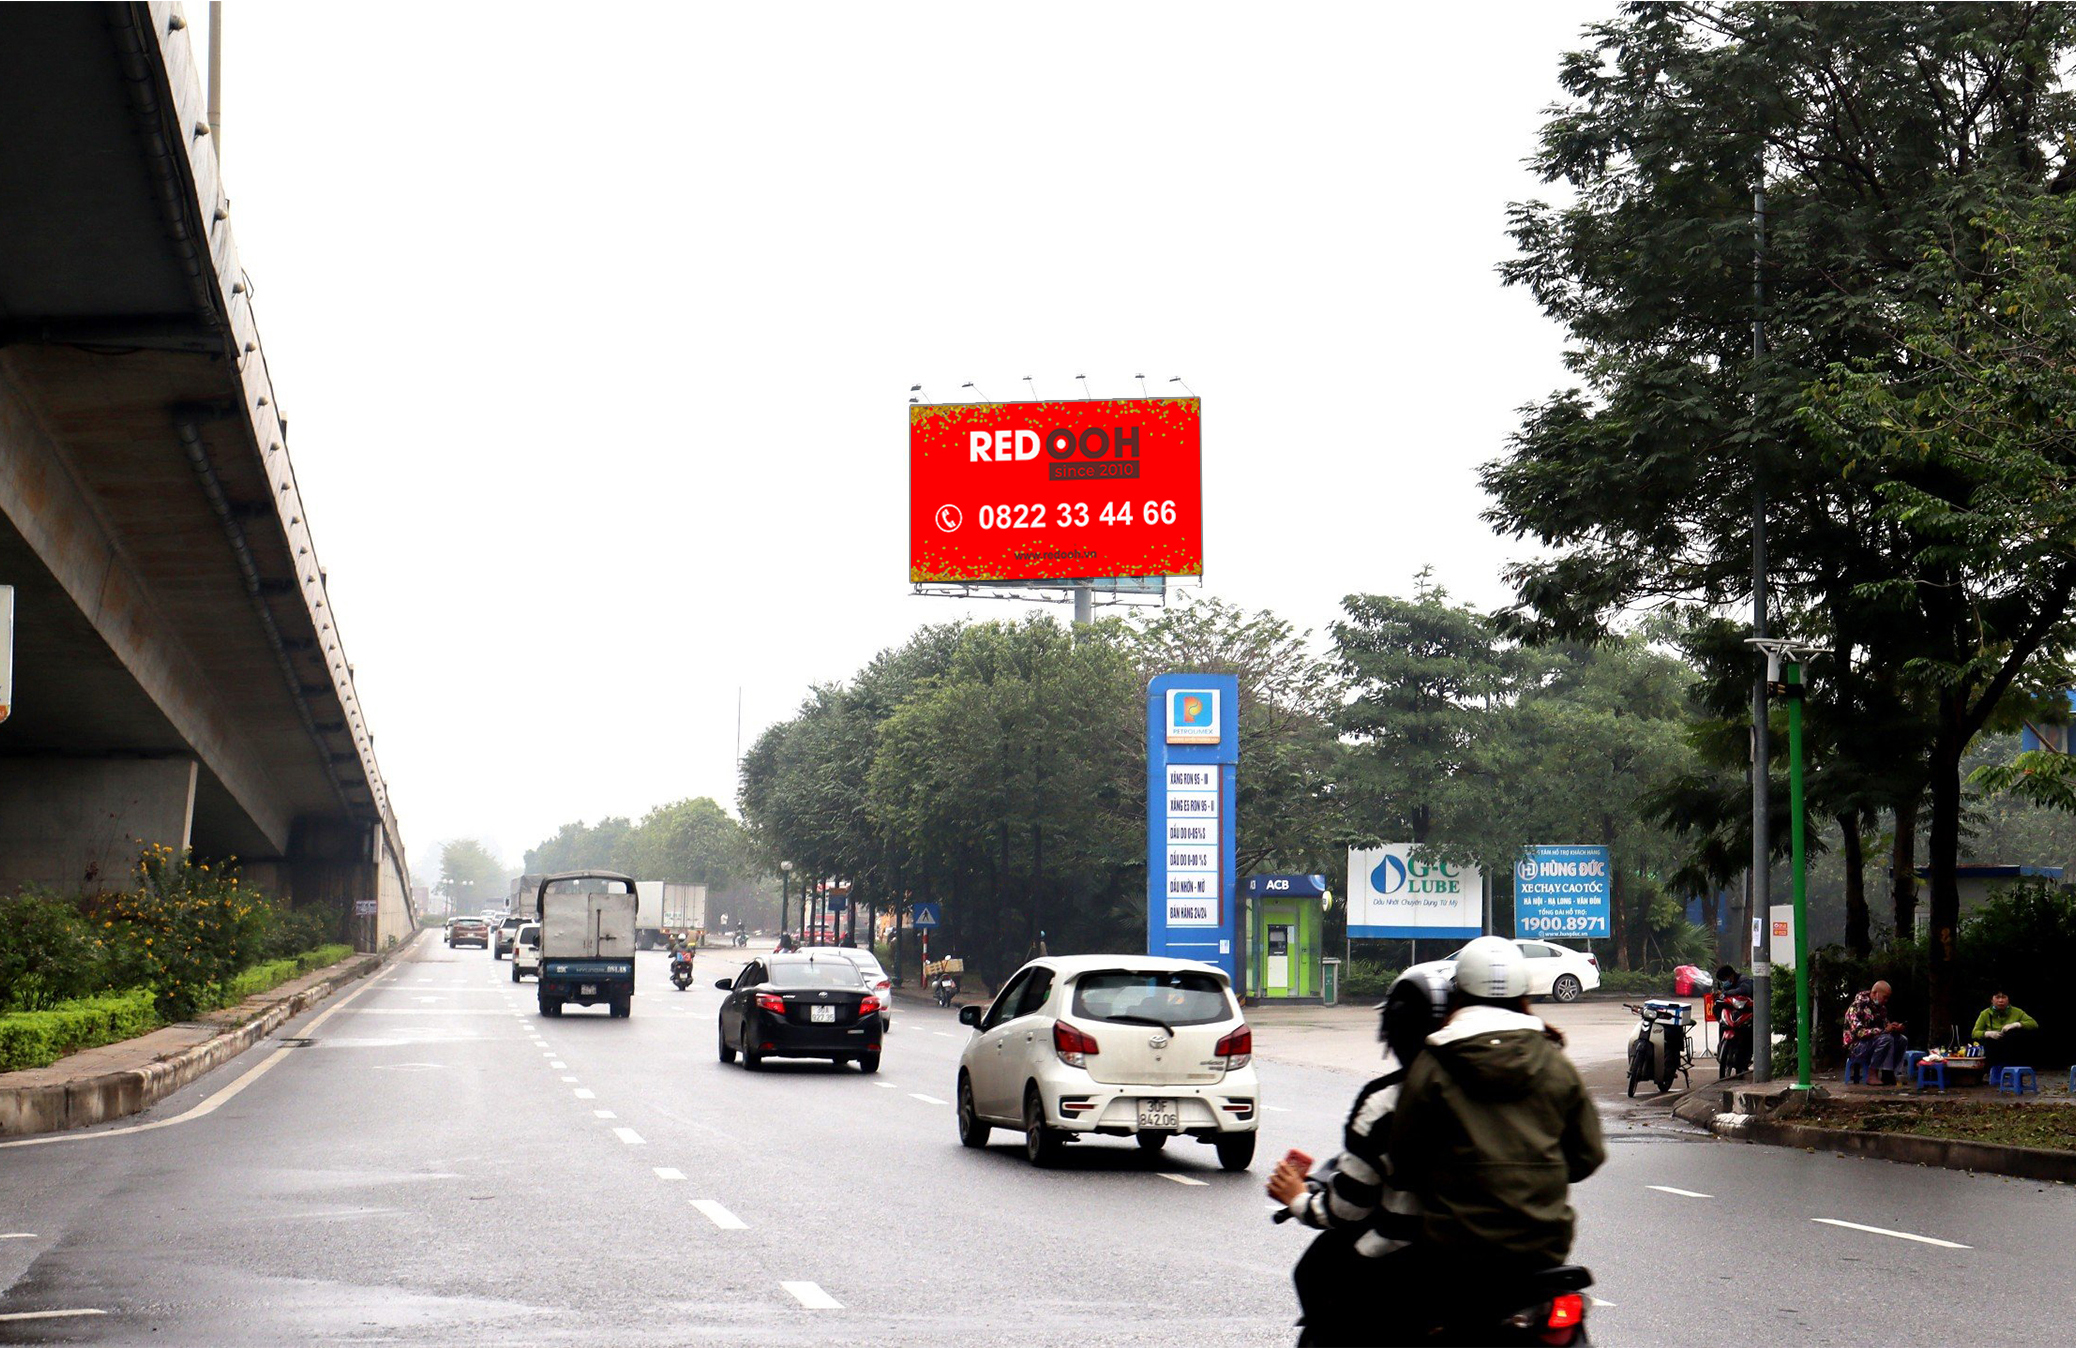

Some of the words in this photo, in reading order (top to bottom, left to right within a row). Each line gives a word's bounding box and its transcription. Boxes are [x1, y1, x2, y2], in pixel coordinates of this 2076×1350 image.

[1055, 464, 1095, 478] since
[1099, 463, 1134, 477] 2010
[978, 503, 1046, 530] 0822
[1056, 502, 1090, 528] 33
[1099, 501, 1133, 526] 44
[1143, 499, 1177, 525] 66
[1014, 549, 1097, 561] www.redooh.vn
[1184, 773, 1193, 785] RON
[1194, 773, 1200, 785] 95
[1540, 859, 1577, 877] HÙNG
[1579, 859, 1605, 877] ĐỨC
[1266, 879, 1290, 890] ACB
[1407, 879, 1461, 894] LUBE
[1521, 883, 1534, 893] XE
[1534, 883, 1561, 894] CHẠY
[1562, 883, 1582, 893] CAO
[1583, 880, 1603, 893] TỐC
[1523, 896, 1531, 905] HÀ
[1557, 897, 1572, 905] LONG
[1194, 907, 1207, 919] 24/24
[1521, 916, 1605, 931] 1900.8971
